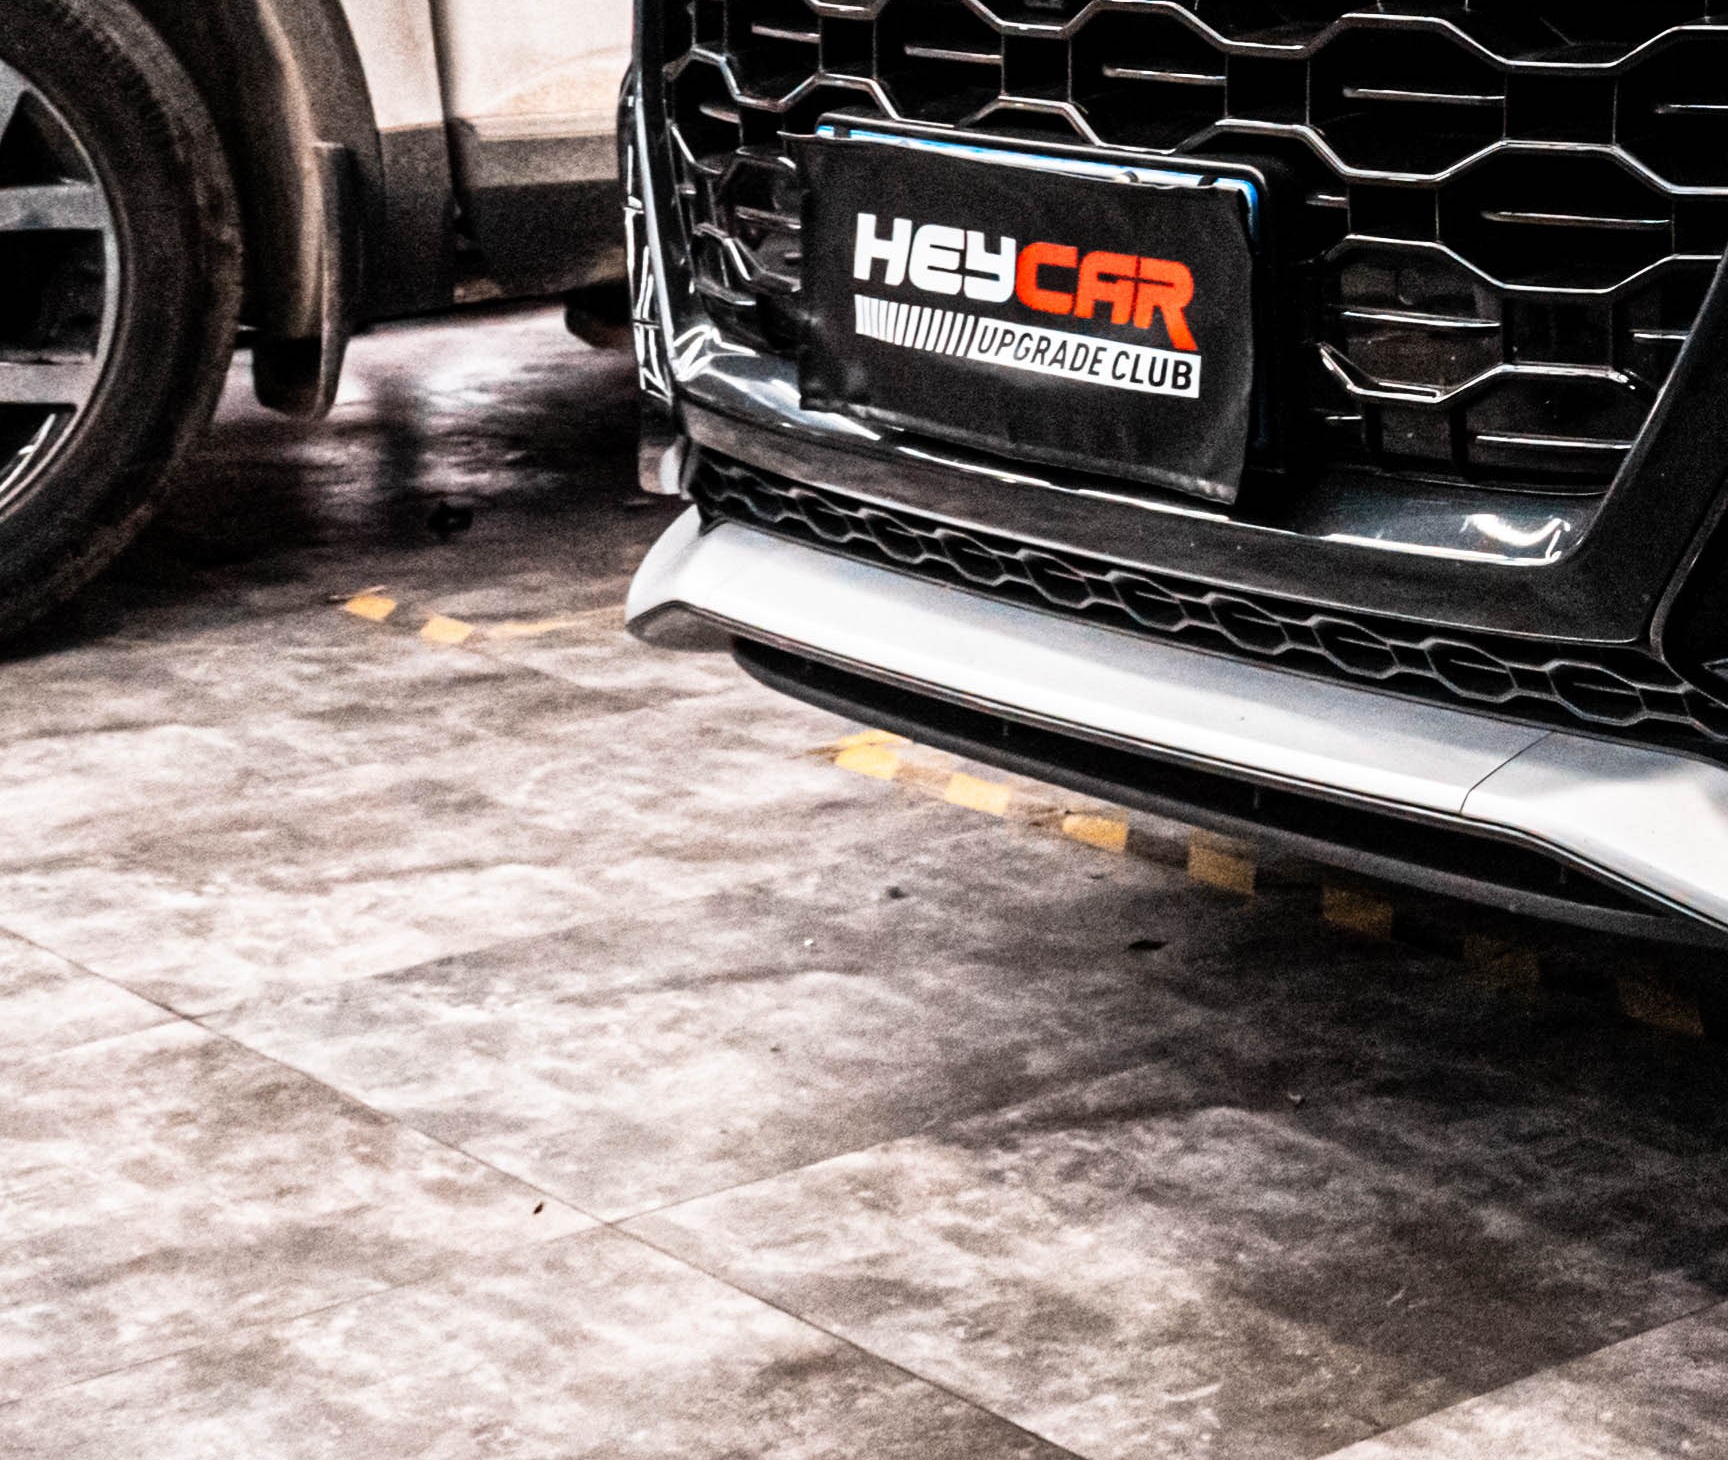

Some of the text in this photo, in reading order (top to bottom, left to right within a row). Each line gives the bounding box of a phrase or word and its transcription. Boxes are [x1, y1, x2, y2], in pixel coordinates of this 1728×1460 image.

[854, 212, 1198, 352] HEYCAR
[977, 323, 1193, 391] UPGRADE CLUB
